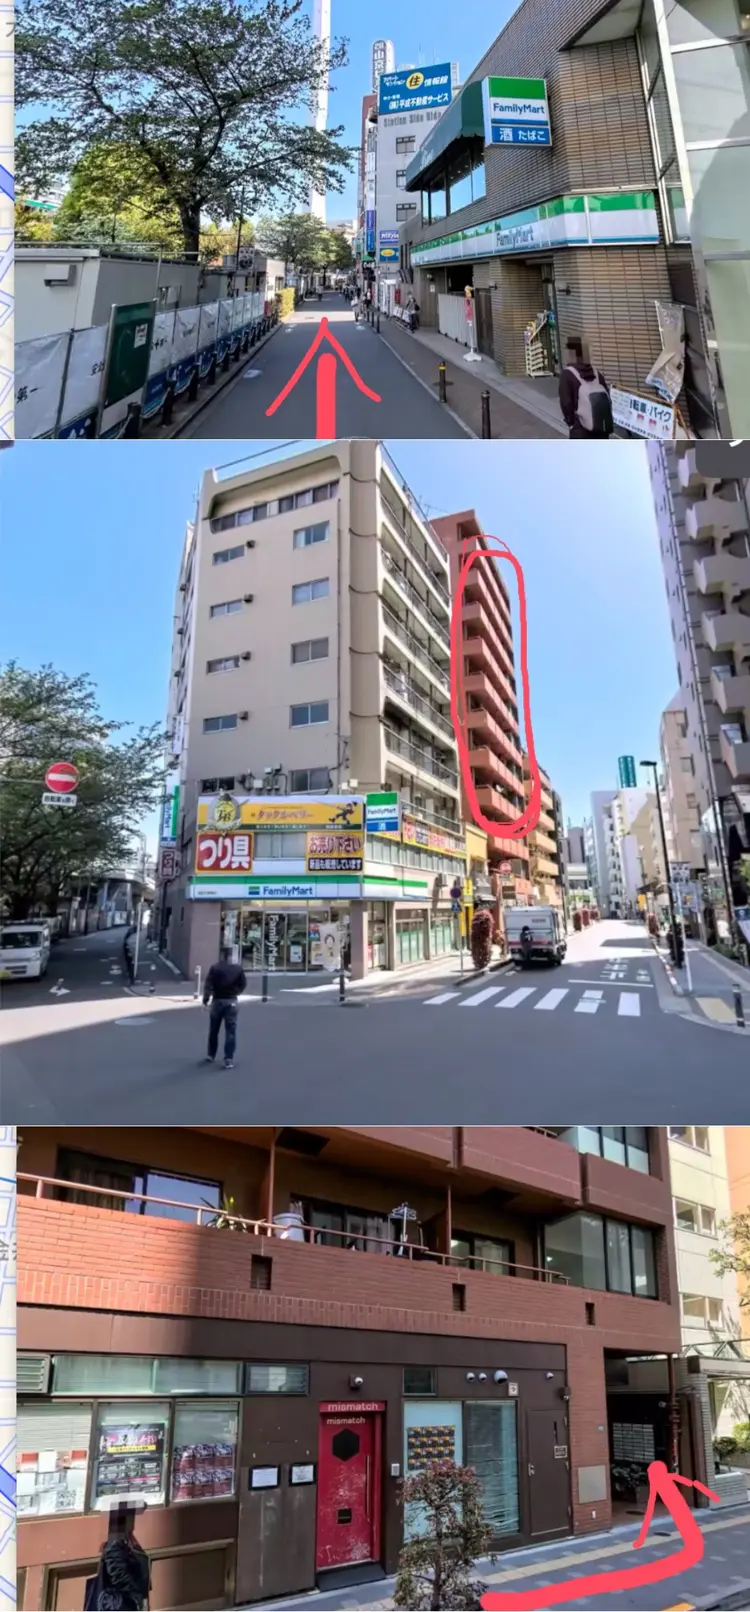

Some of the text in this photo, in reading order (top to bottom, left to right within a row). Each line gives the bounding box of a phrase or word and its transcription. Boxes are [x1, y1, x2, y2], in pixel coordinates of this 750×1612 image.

[409, 76, 421, 87] 住
[493, 103, 545, 114] FamilyMart
[384, 116, 407, 127] Station
[409, 113, 424, 124] Side
[500, 128, 546, 141] 酒 たばこ
[496, 225, 534, 248] FamilyMart
[310, 835, 361, 854] お売り下さい
[199, 836, 250, 868] つり具
[263, 886, 313, 896] FamilyMart
[266, 915, 279, 971] FamilyMart
[328, 1402, 379, 1411] mismatch
[326, 1416, 366, 1425] mismatch
